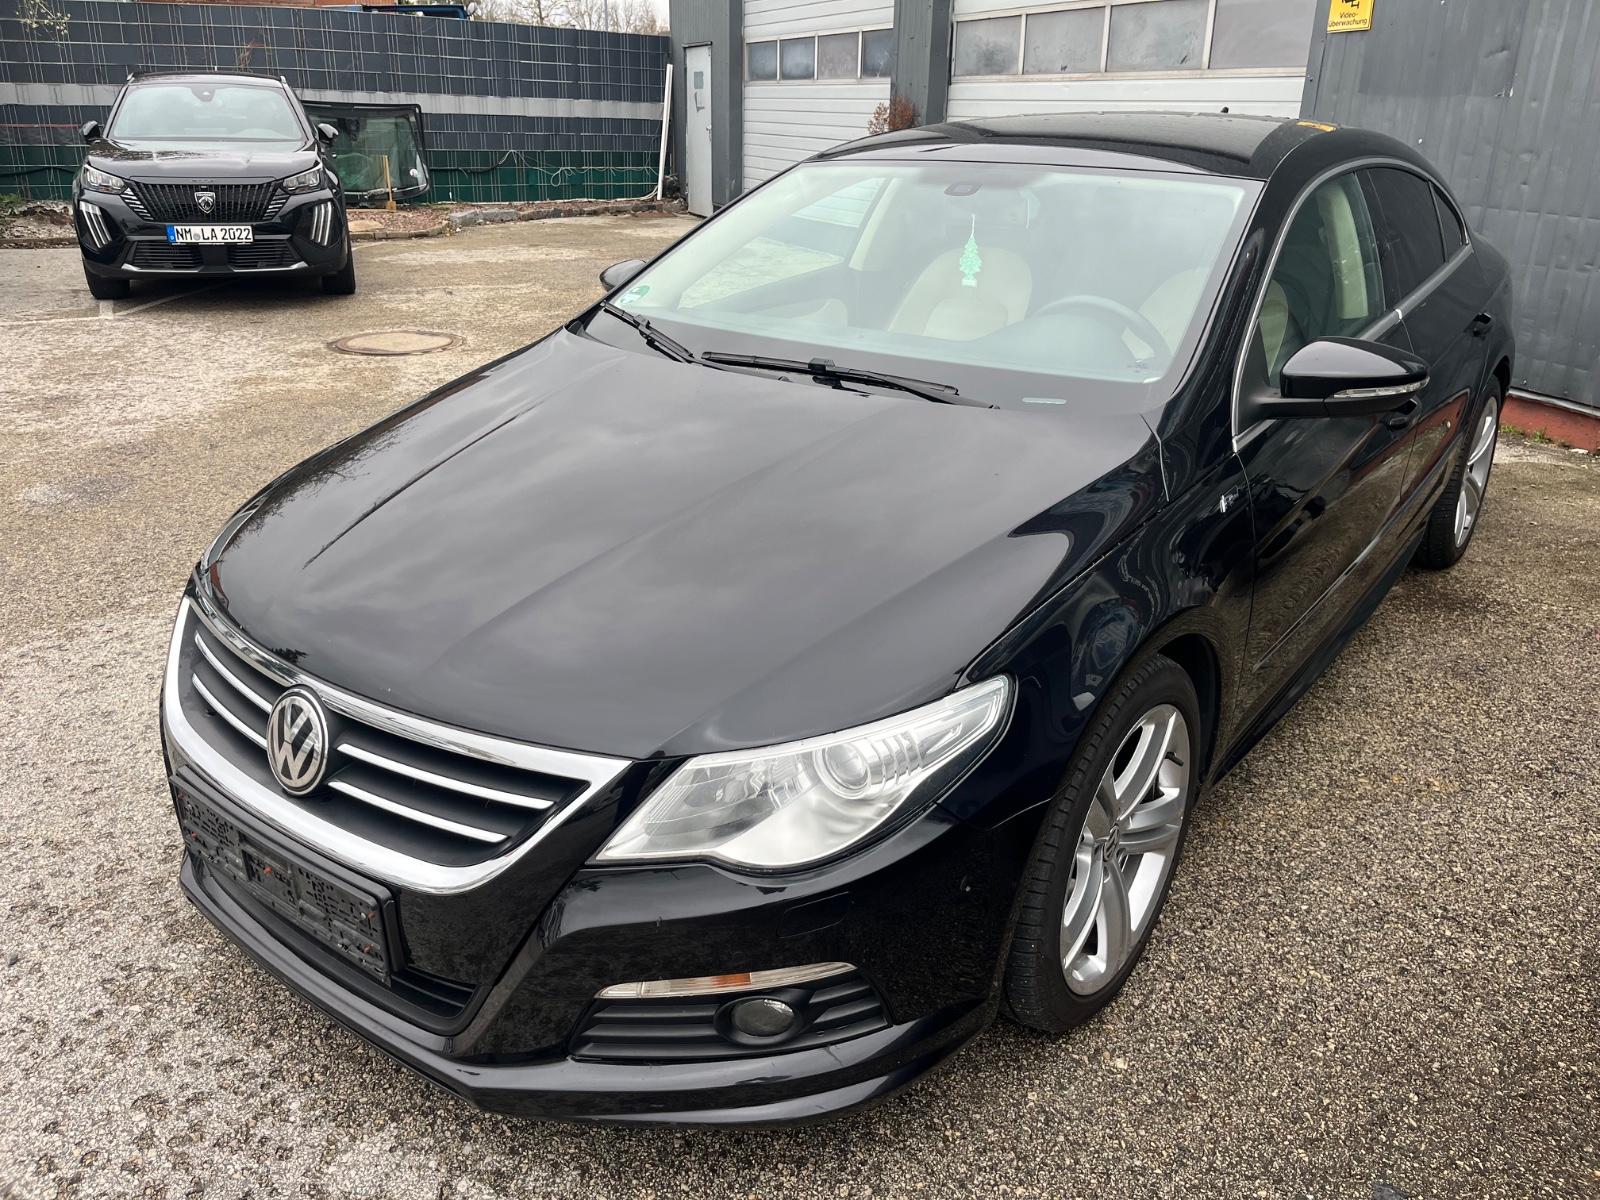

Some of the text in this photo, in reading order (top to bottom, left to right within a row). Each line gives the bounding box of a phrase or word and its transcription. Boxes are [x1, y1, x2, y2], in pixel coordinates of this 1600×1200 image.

[175, 227, 252, 241] NM LA 2022
[273, 696, 322, 788] VW
